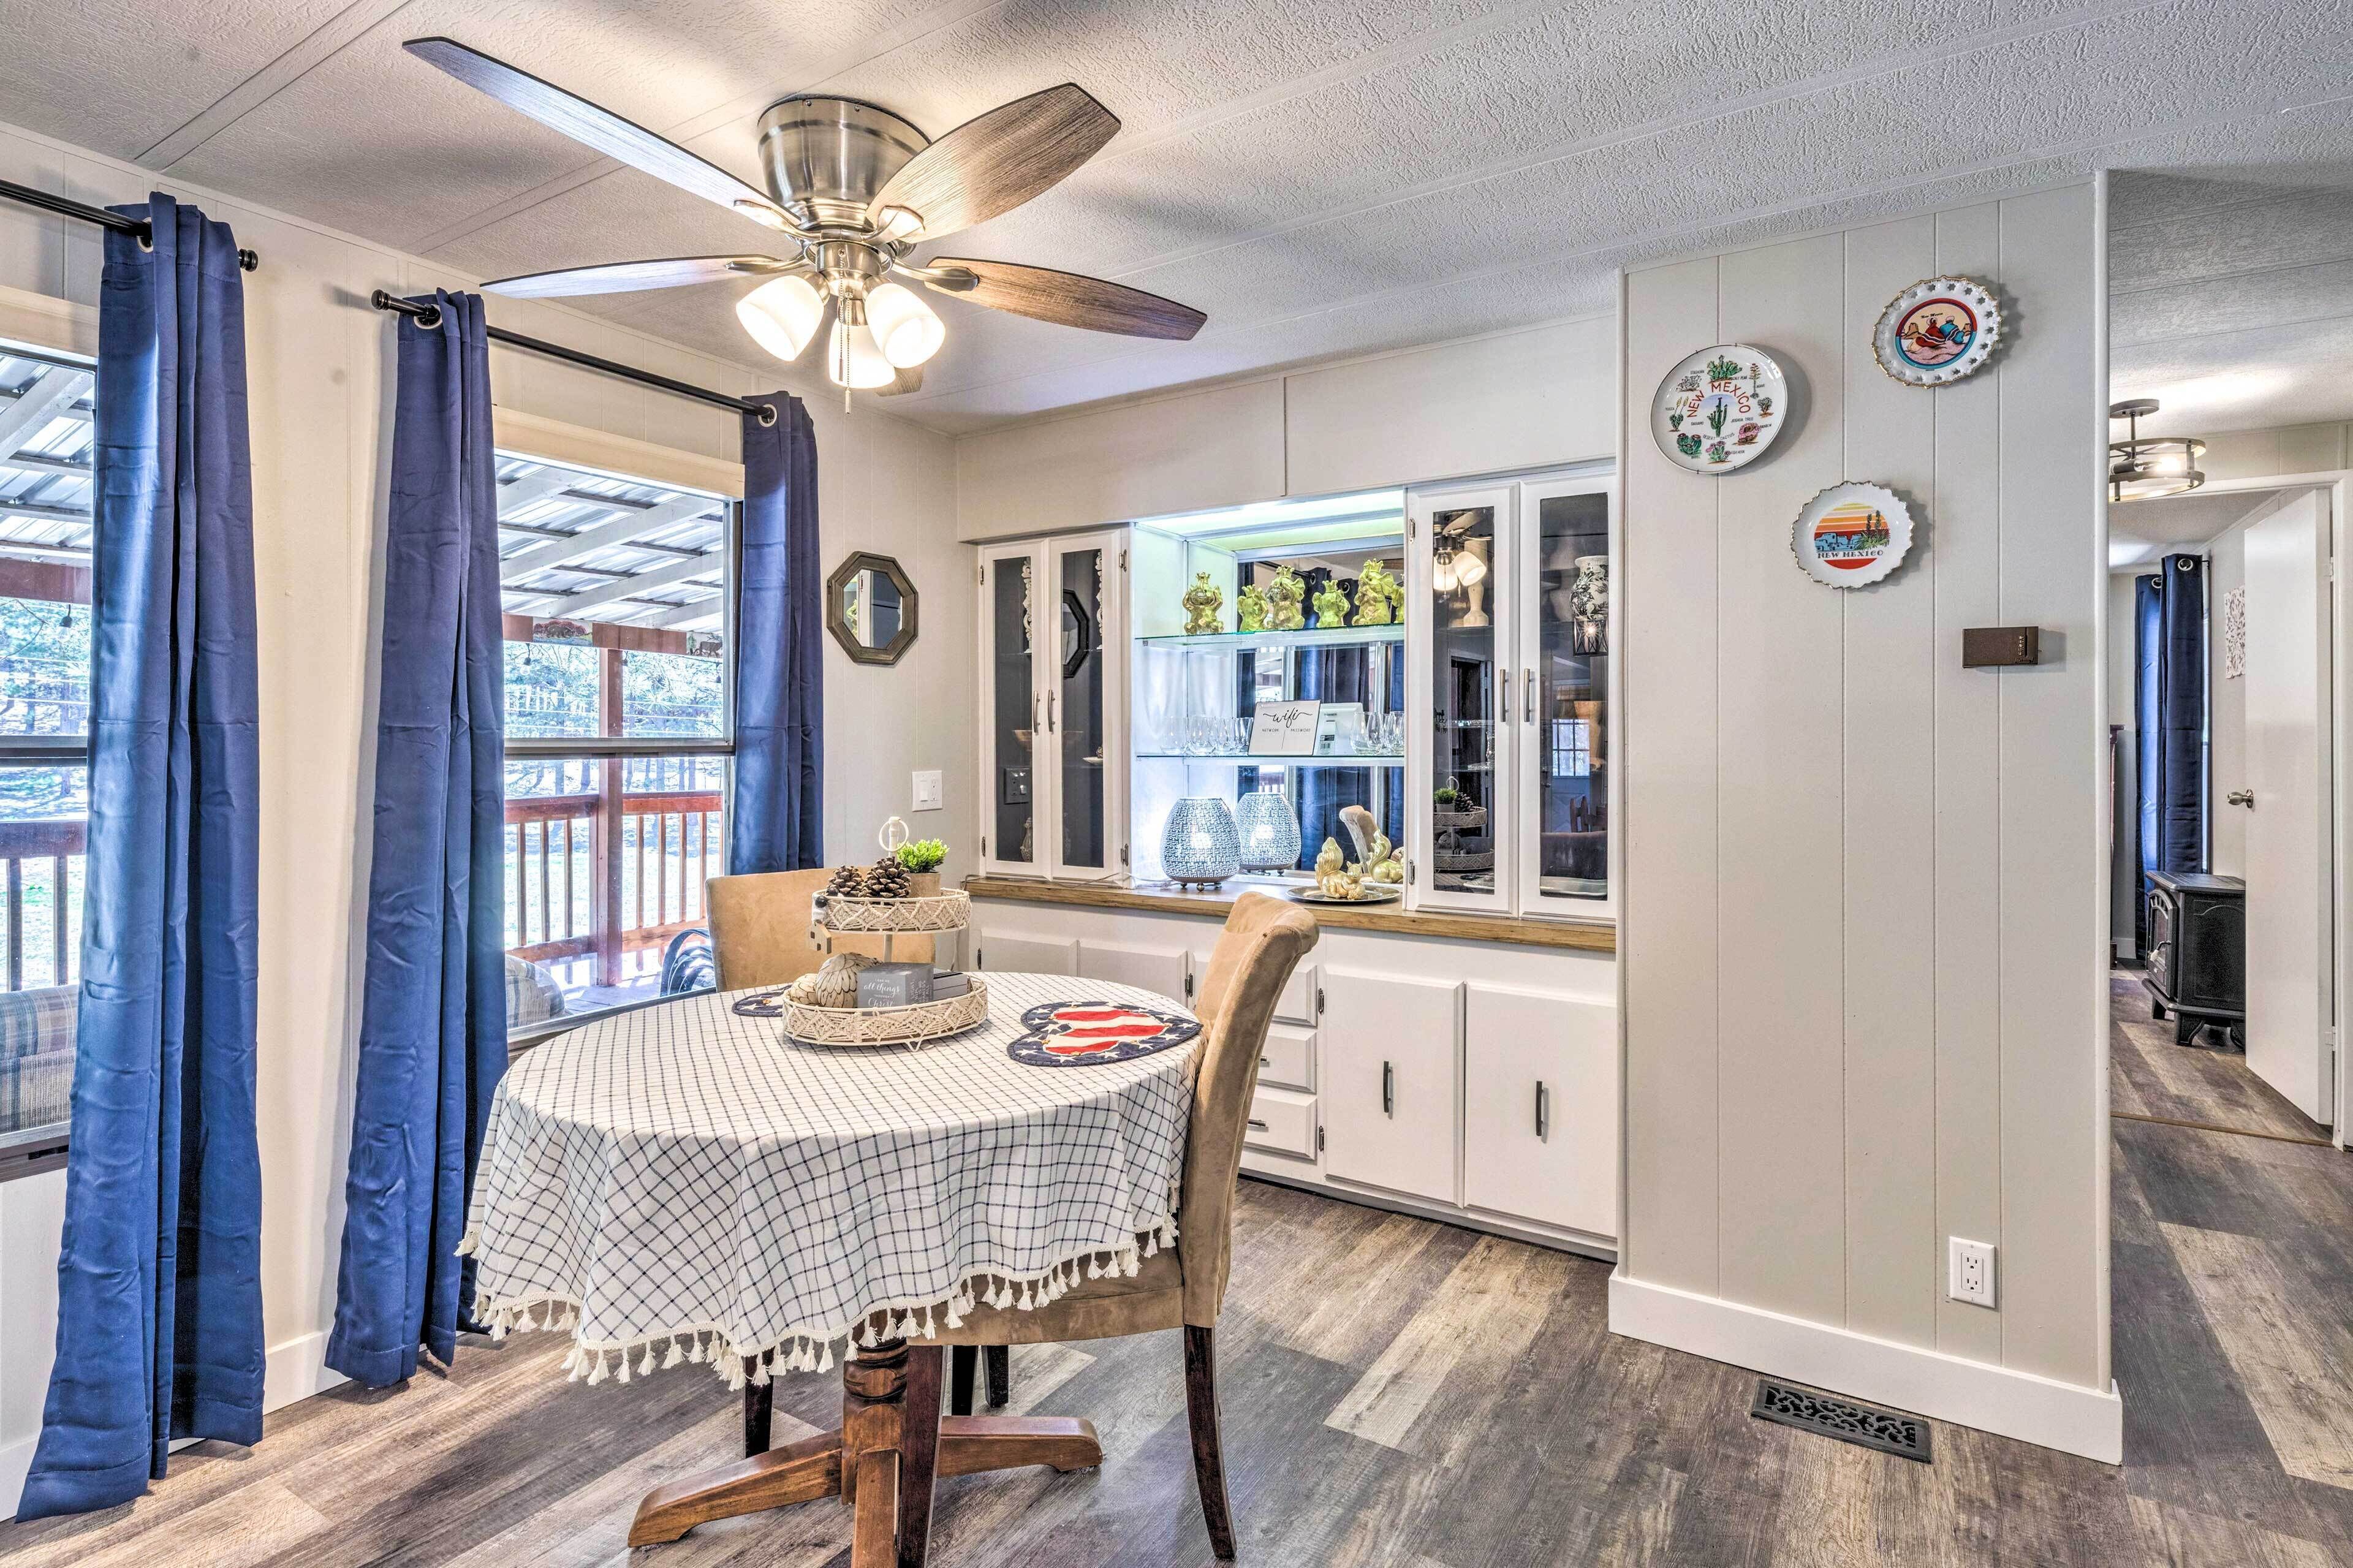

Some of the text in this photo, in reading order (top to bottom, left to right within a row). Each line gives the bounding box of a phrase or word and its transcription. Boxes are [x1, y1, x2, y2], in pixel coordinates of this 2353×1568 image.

[1687, 381, 1751, 418] NEW MEXICO
[1719, 432, 1735, 441] CACTUS
[1263, 707, 1313, 729] wifi
[863, 982, 876, 991] all
[876, 983, 900, 998] things
